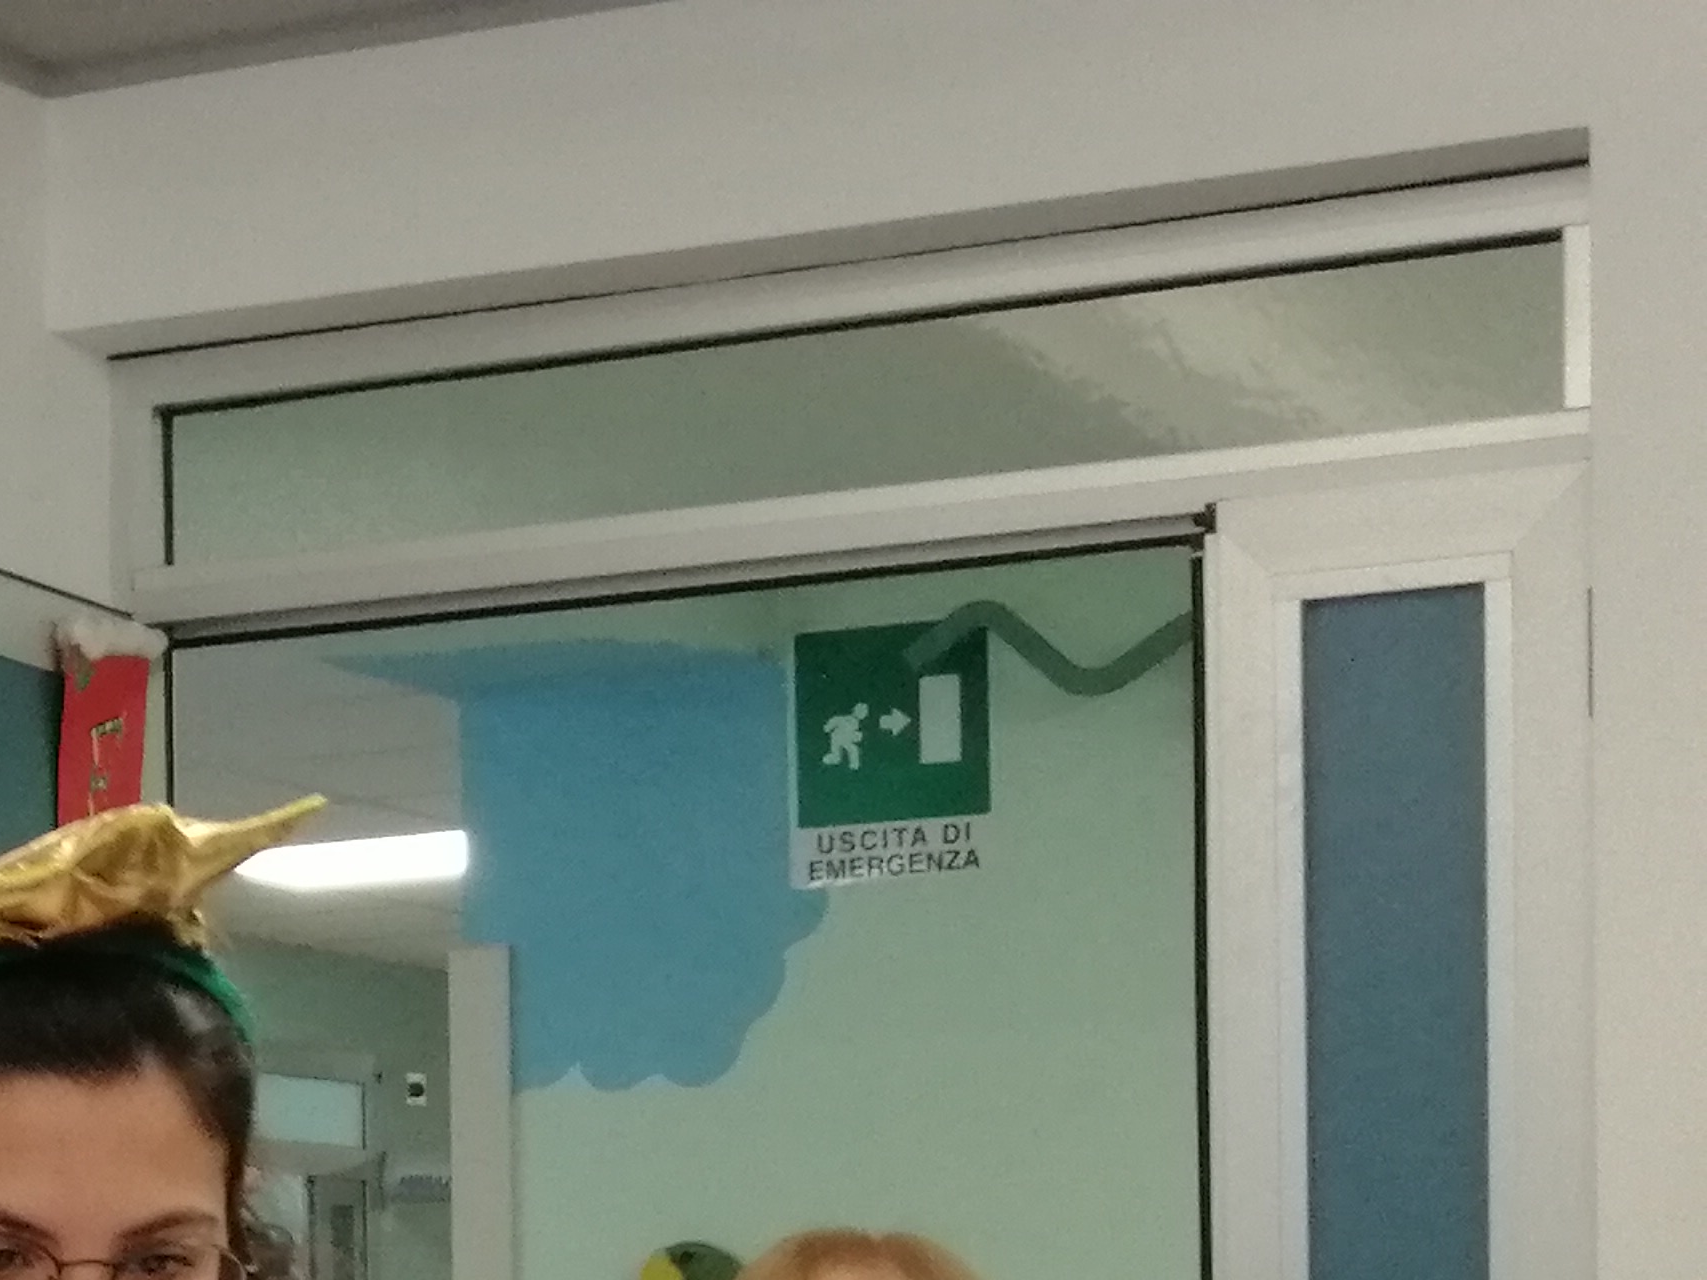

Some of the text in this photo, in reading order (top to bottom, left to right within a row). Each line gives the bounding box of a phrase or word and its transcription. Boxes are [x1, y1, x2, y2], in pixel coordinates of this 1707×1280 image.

[817, 821, 971, 854] USCITA DI
[809, 848, 980, 881] EMERGENZA
